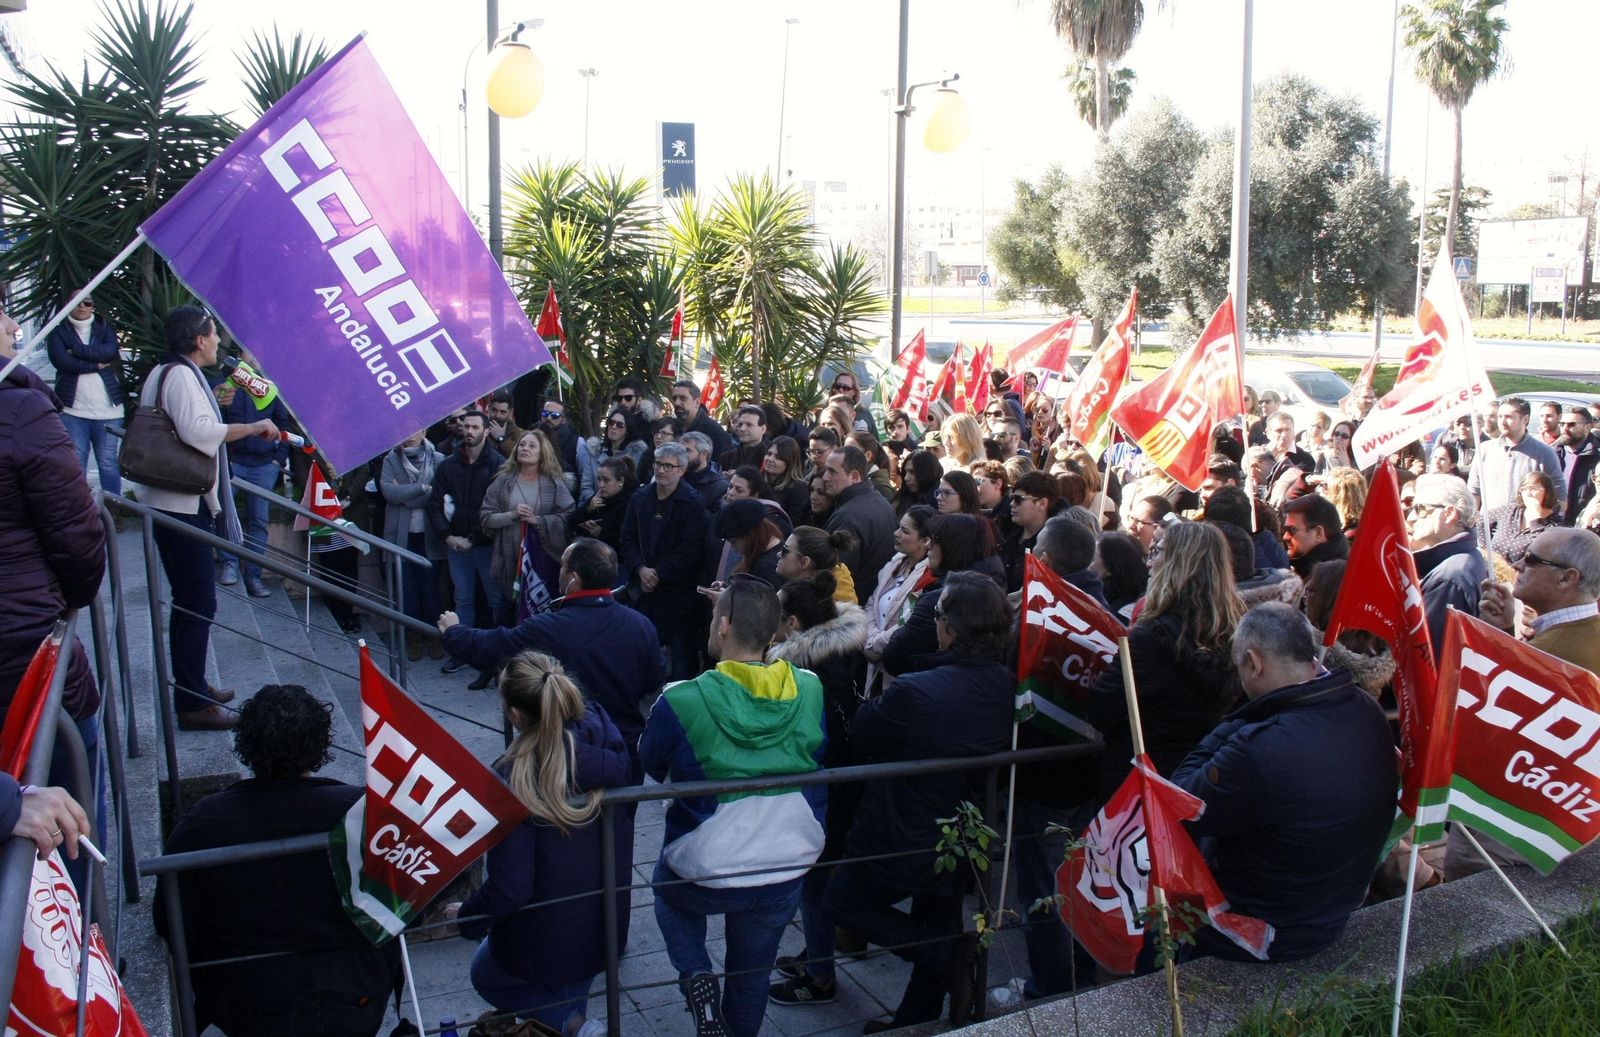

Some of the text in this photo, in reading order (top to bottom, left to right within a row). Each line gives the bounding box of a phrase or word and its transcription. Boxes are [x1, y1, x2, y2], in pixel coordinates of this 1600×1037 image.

[260, 117, 439, 346] CCOO
[314, 285, 411, 410] Andalucía
[1504, 749, 1600, 823] Cádiz
[369, 823, 440, 886] Cádiz
